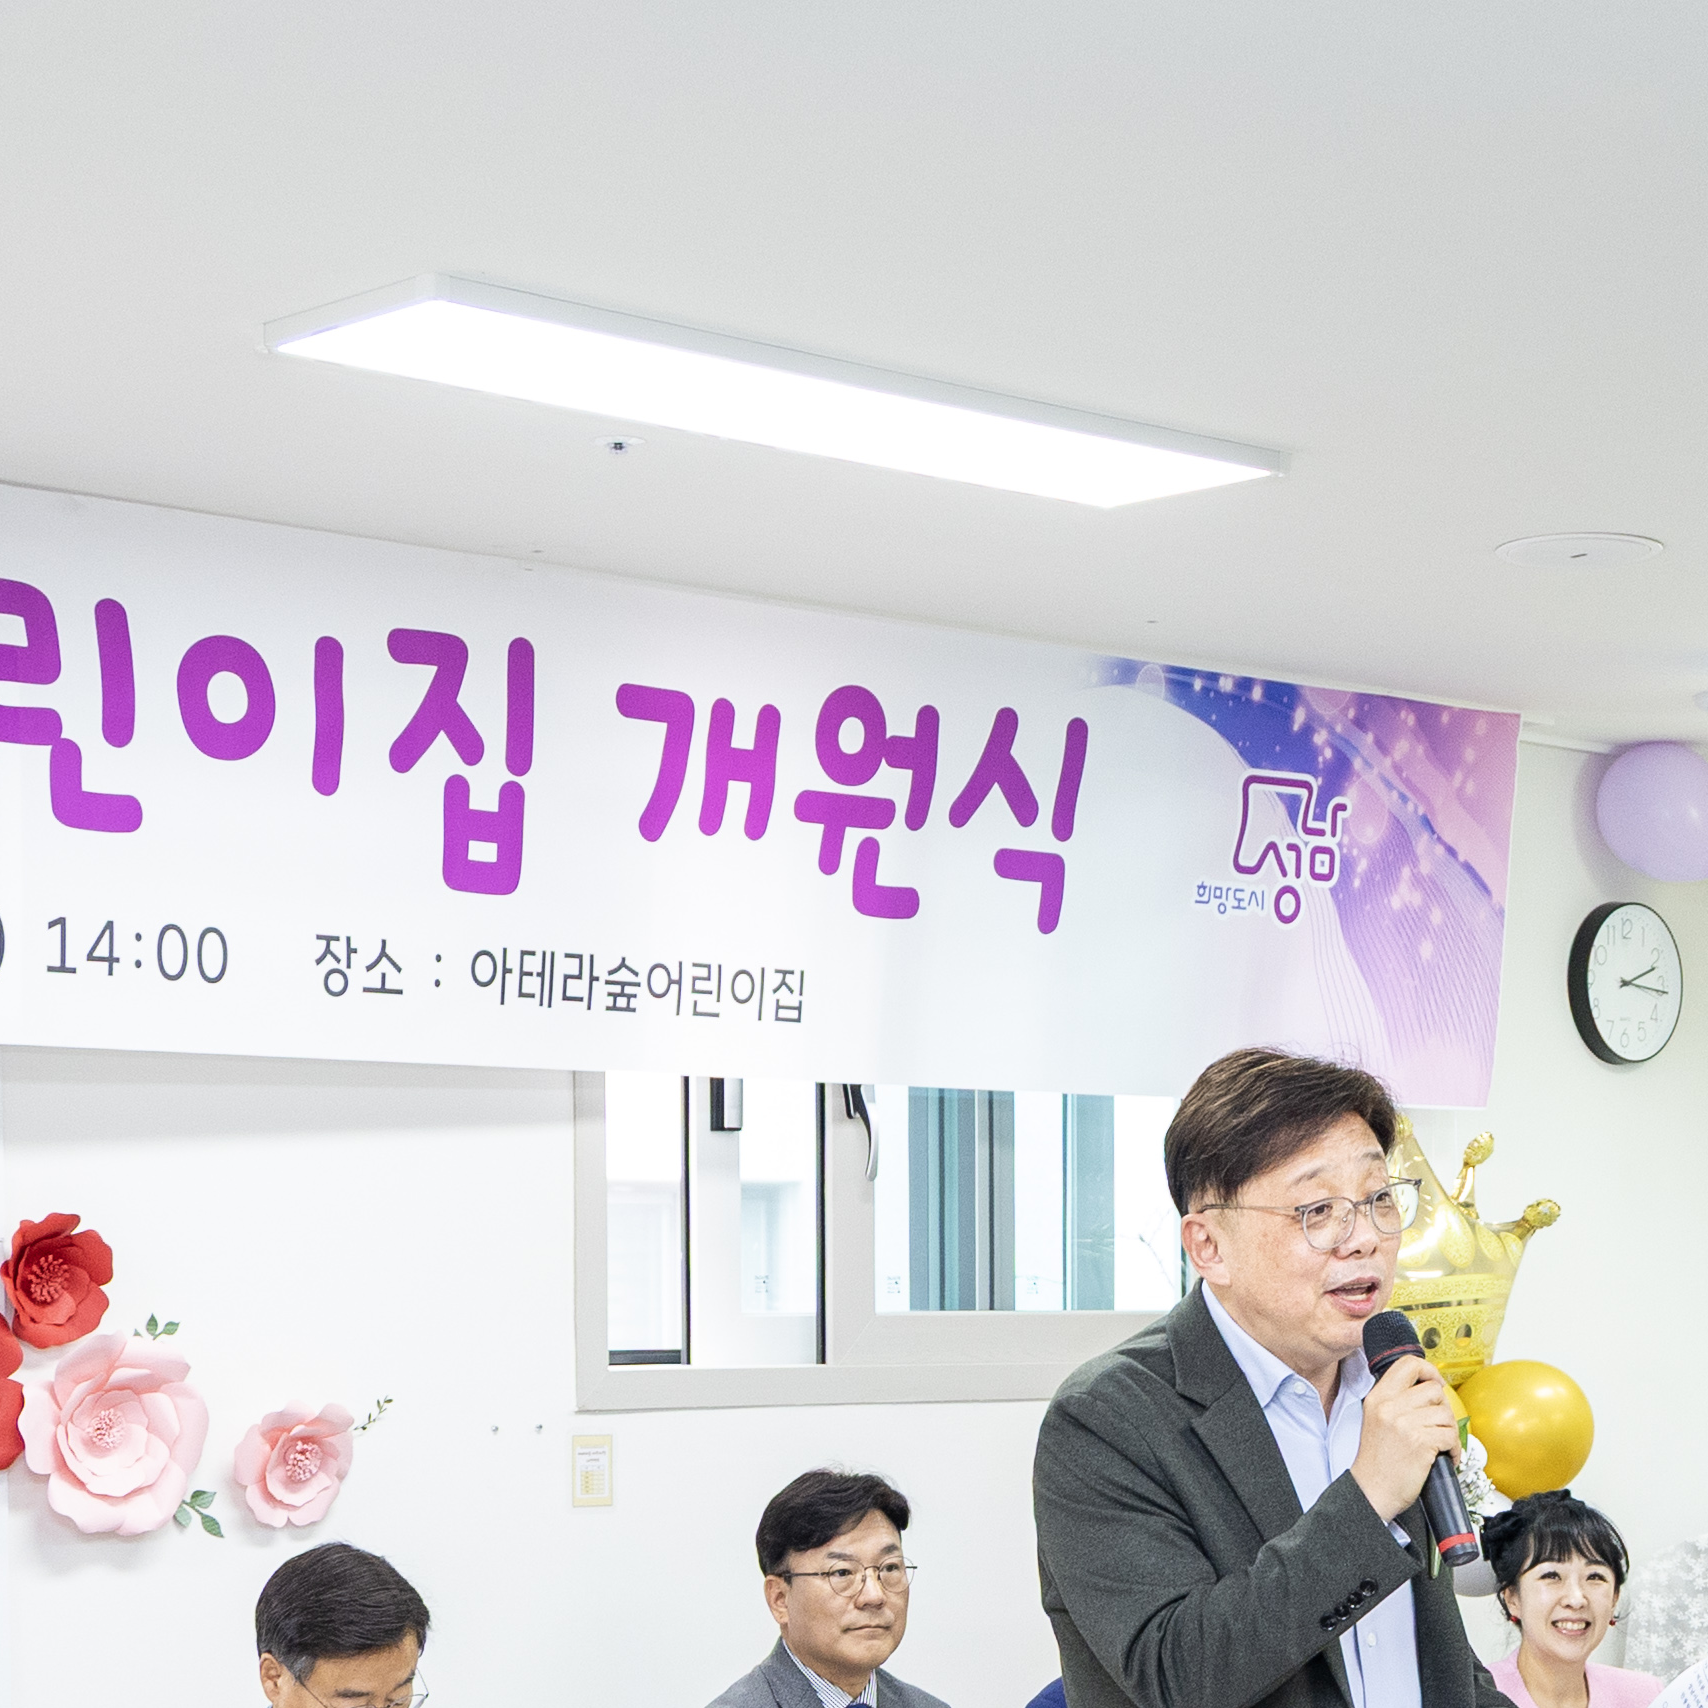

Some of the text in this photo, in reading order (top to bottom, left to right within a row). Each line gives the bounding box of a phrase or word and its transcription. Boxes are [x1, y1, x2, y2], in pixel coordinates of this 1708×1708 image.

[616, 683, 1089, 935] 개원식
[1194, 881, 1265, 915] 희망도시
[1621, 918, 1633, 939] 12
[45, 915, 229, 984] 14:00
[1651, 948, 1660, 968] 2
[314, 933, 404, 998] 장소
[470, 946, 805, 1024] 아테라숲어린이집
[1650, 1003, 1659, 1023] 4
[1606, 1020, 1615, 1040] 7
[1620, 1027, 1630, 1048] 6
[1638, 1021, 1647, 1042] 5
